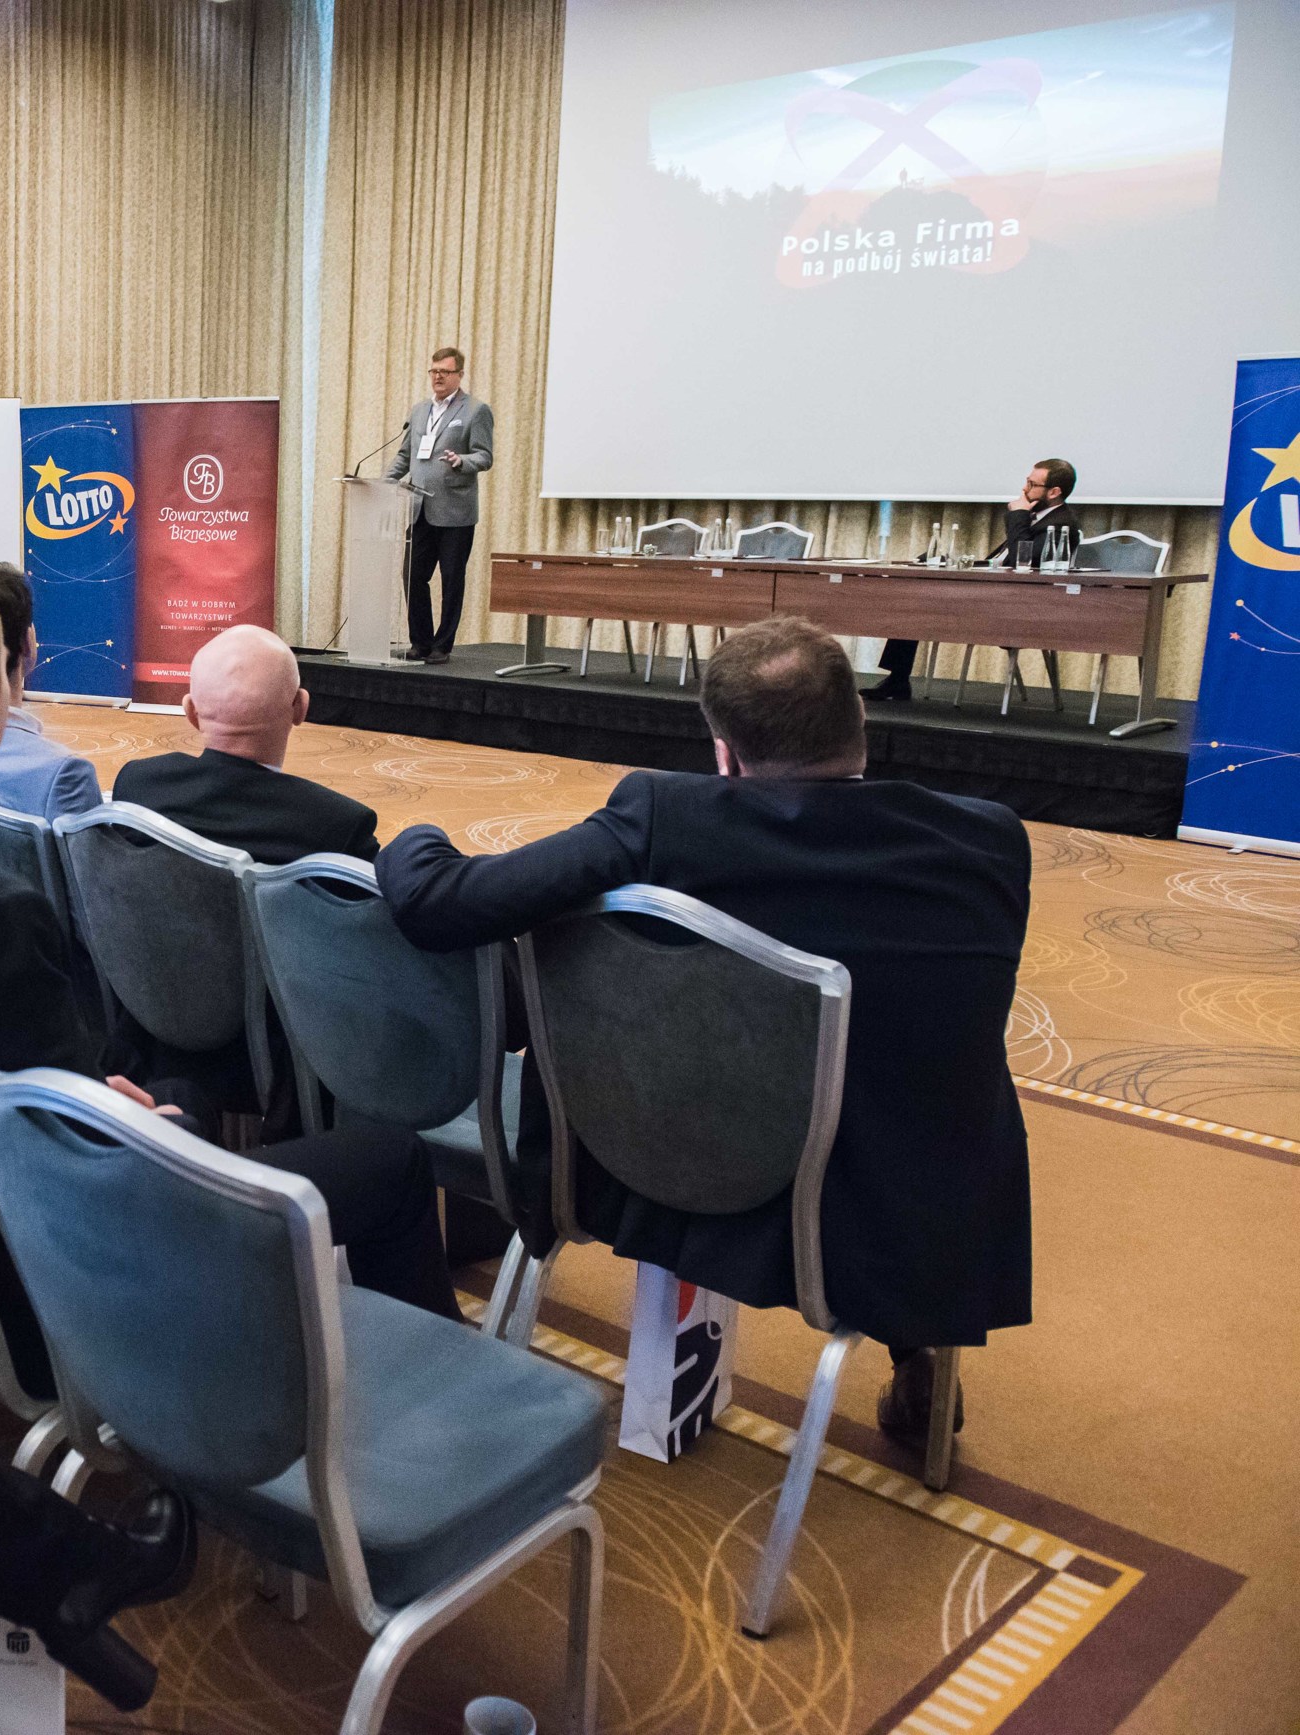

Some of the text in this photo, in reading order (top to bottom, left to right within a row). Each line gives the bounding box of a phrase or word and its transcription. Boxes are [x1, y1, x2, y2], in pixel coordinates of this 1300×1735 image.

[782, 217, 1019, 256] Polska Firma
[802, 241, 993, 278] na podbój świata!
[45, 485, 113, 526] LOTTO
[158, 507, 249, 526] Towarzystwa
[168, 524, 238, 543] Biznesowe
[201, 601, 236, 609] DOBRYM
[170, 612, 233, 621] TOWARZYSTWIE
